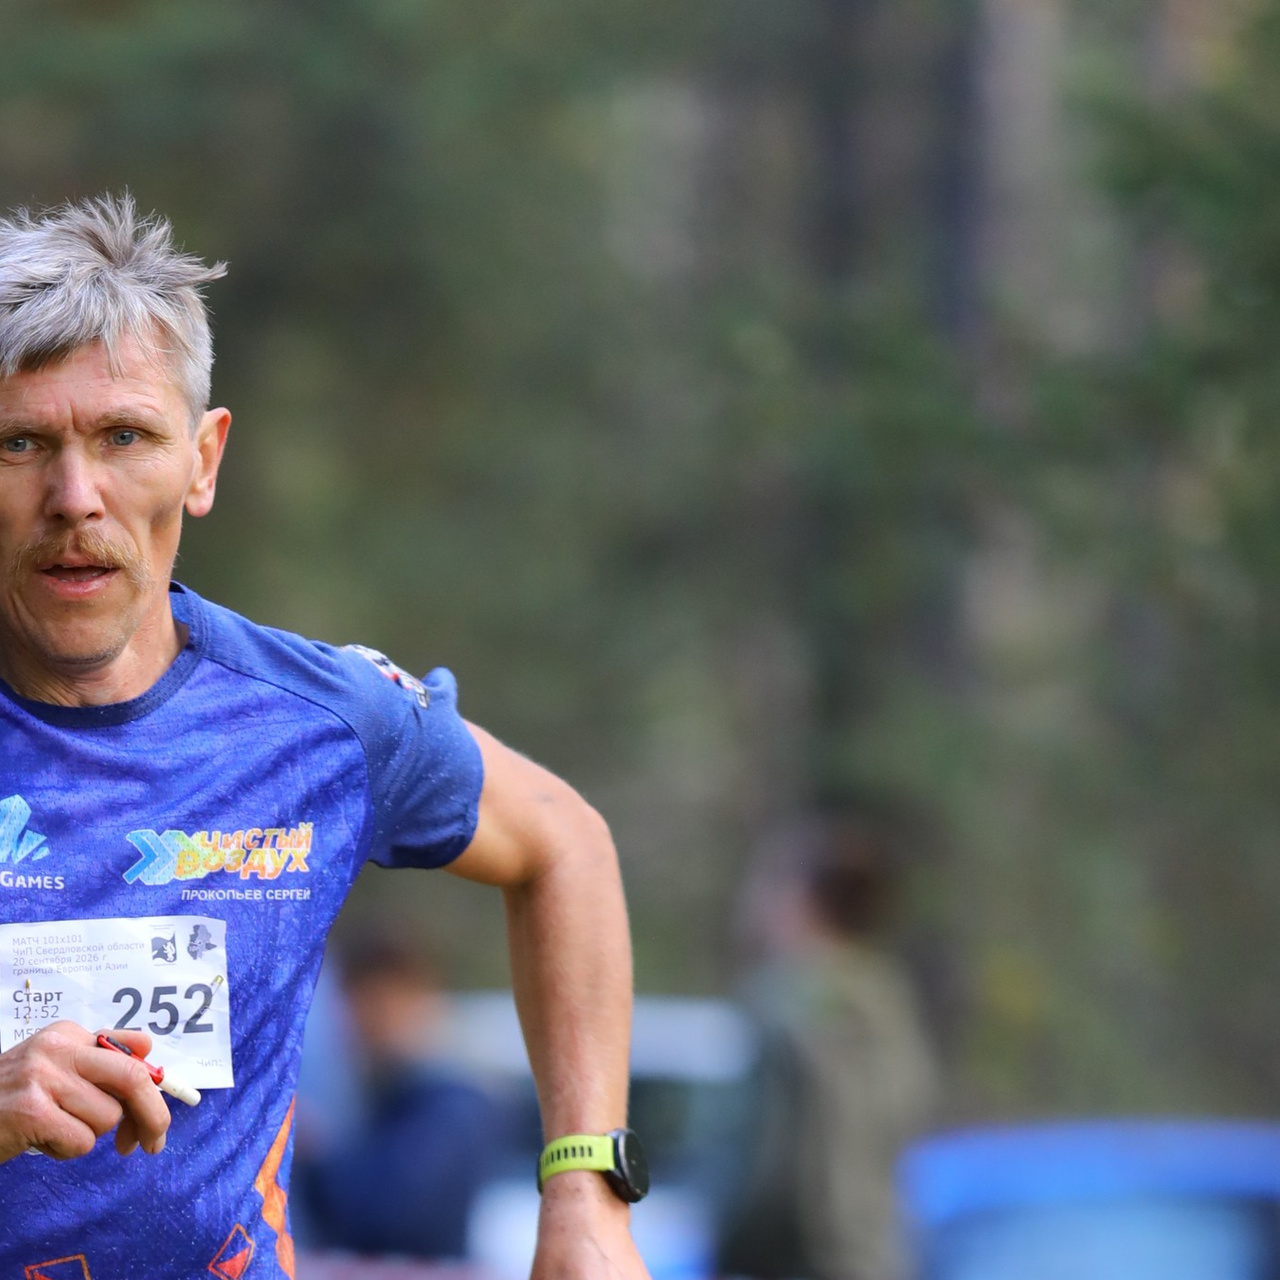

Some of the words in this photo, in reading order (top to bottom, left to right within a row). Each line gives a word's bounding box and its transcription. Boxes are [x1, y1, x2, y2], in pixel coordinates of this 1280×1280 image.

[181, 889, 263, 901] ПРОКОПЬЕВ
[265, 887, 311, 901] СЕРГЕЙ
[12, 936, 39, 946] МАТЧ
[35, 944, 104, 957] Свердловской
[106, 941, 145, 951] области
[12, 957, 25, 967] 20
[28, 955, 72, 966] сентября
[75, 953, 100, 963] 2026
[12, 967, 53, 977] граница
[56, 964, 93, 975] Европы
[105, 962, 128, 971] Азии
[12, 989, 63, 1005] Старт
[14, 1005, 60, 1020] 12:52
[111, 982, 214, 1036] 252
